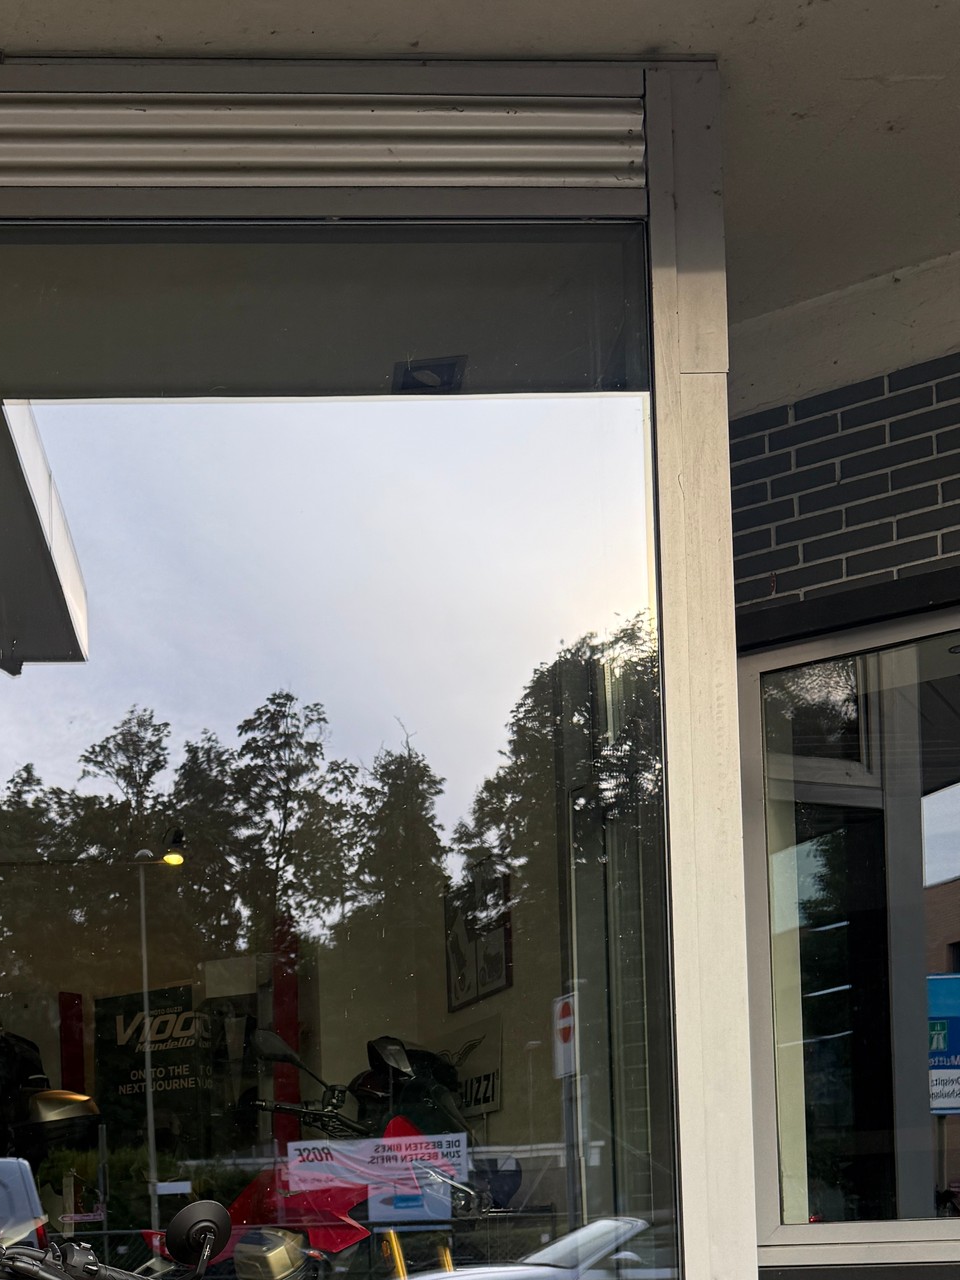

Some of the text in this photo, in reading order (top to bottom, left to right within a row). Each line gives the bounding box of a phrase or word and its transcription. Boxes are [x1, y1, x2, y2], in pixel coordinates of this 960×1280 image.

[134, 1037, 195, 1053] Mandello
[130, 1064, 190, 1080] ON TO THE
[118, 1082, 147, 1095] NEXT
